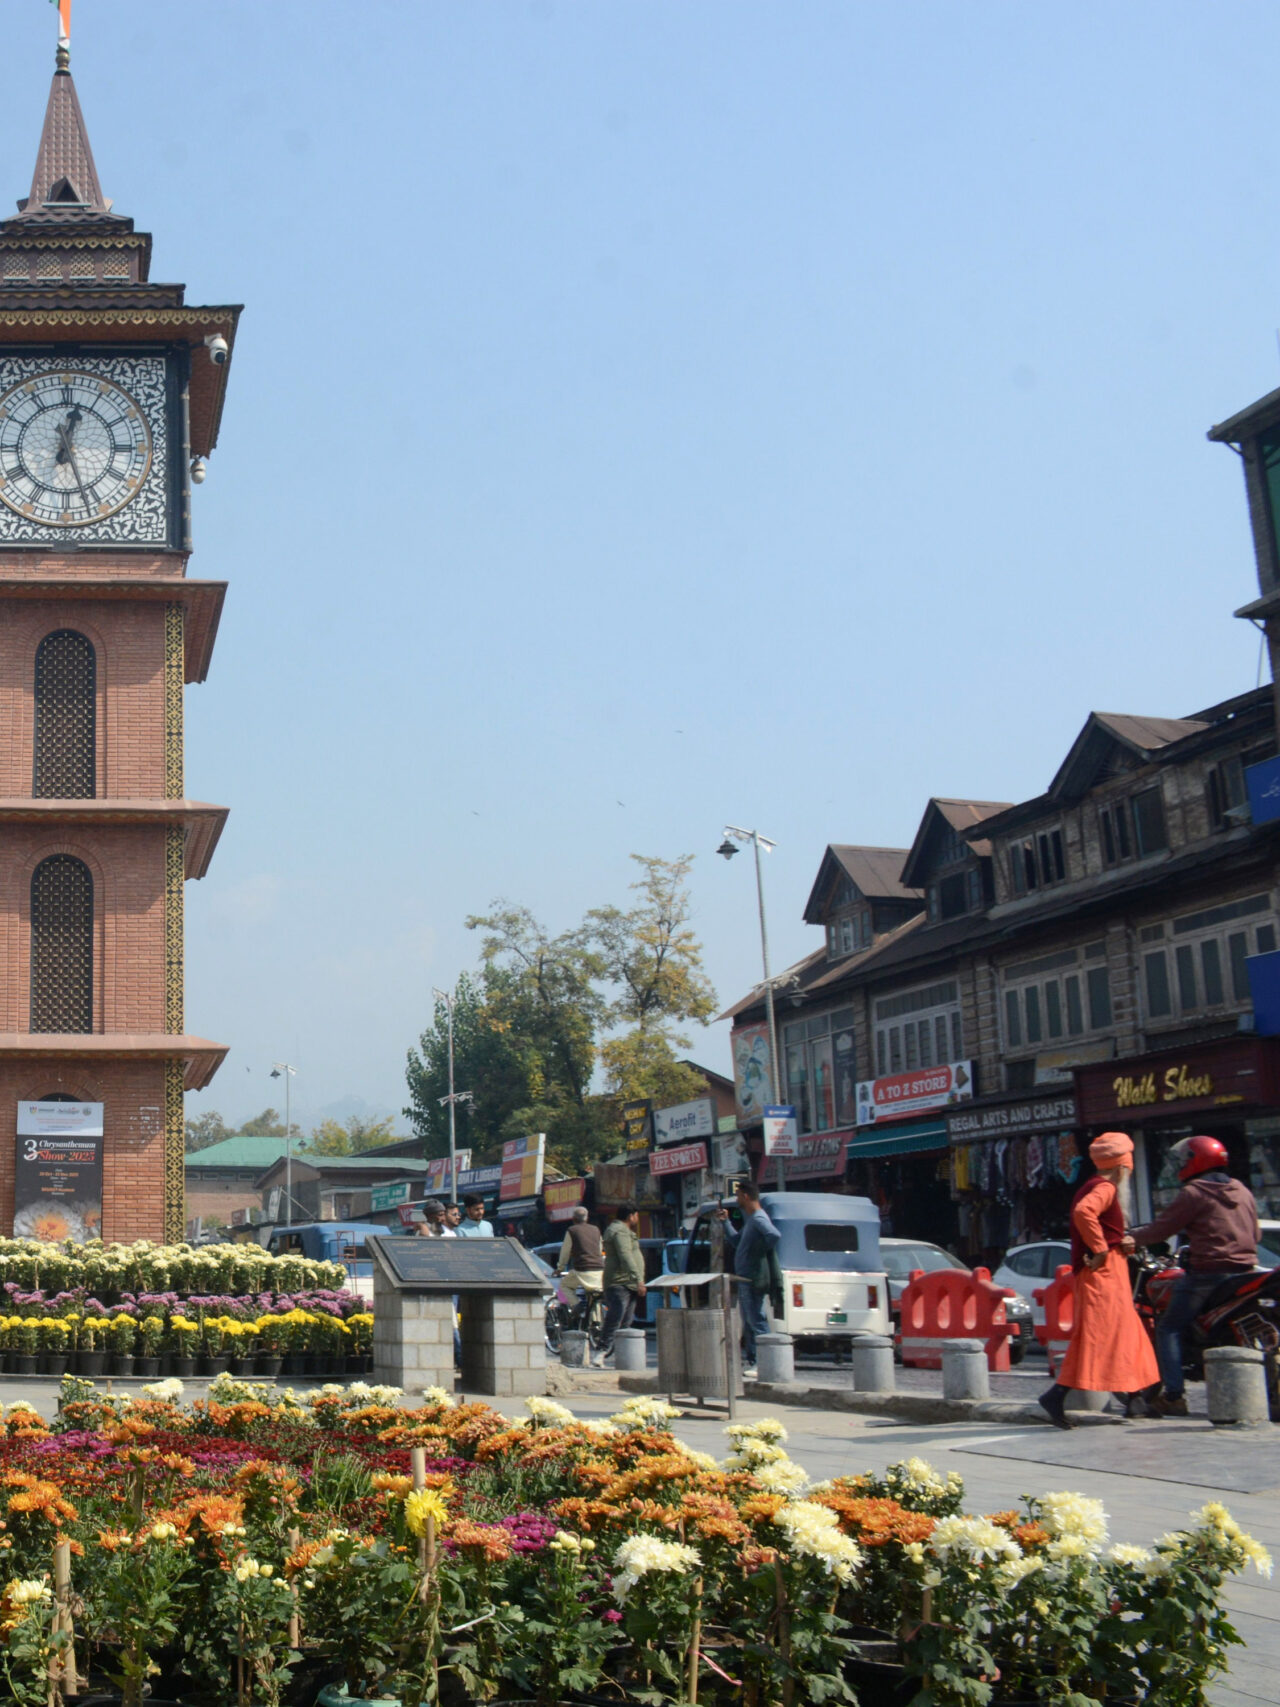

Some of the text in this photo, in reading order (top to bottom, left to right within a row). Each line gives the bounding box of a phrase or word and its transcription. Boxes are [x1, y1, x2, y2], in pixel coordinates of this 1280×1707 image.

[877, 1076, 947, 1101] A TO Z STORE
[1113, 1064, 1213, 1108] Walk Shoes
[670, 1112, 696, 1129] Aerofit
[949, 1115, 980, 1132] REGAL
[982, 1110, 1008, 1127] ARTS
[1010, 1106, 1031, 1123] AND
[1033, 1099, 1075, 1119] CRAFTS
[24, 1139, 96, 1161] 3 Chrysanthemum
[654, 1148, 701, 1170] ZEE SPORTS
